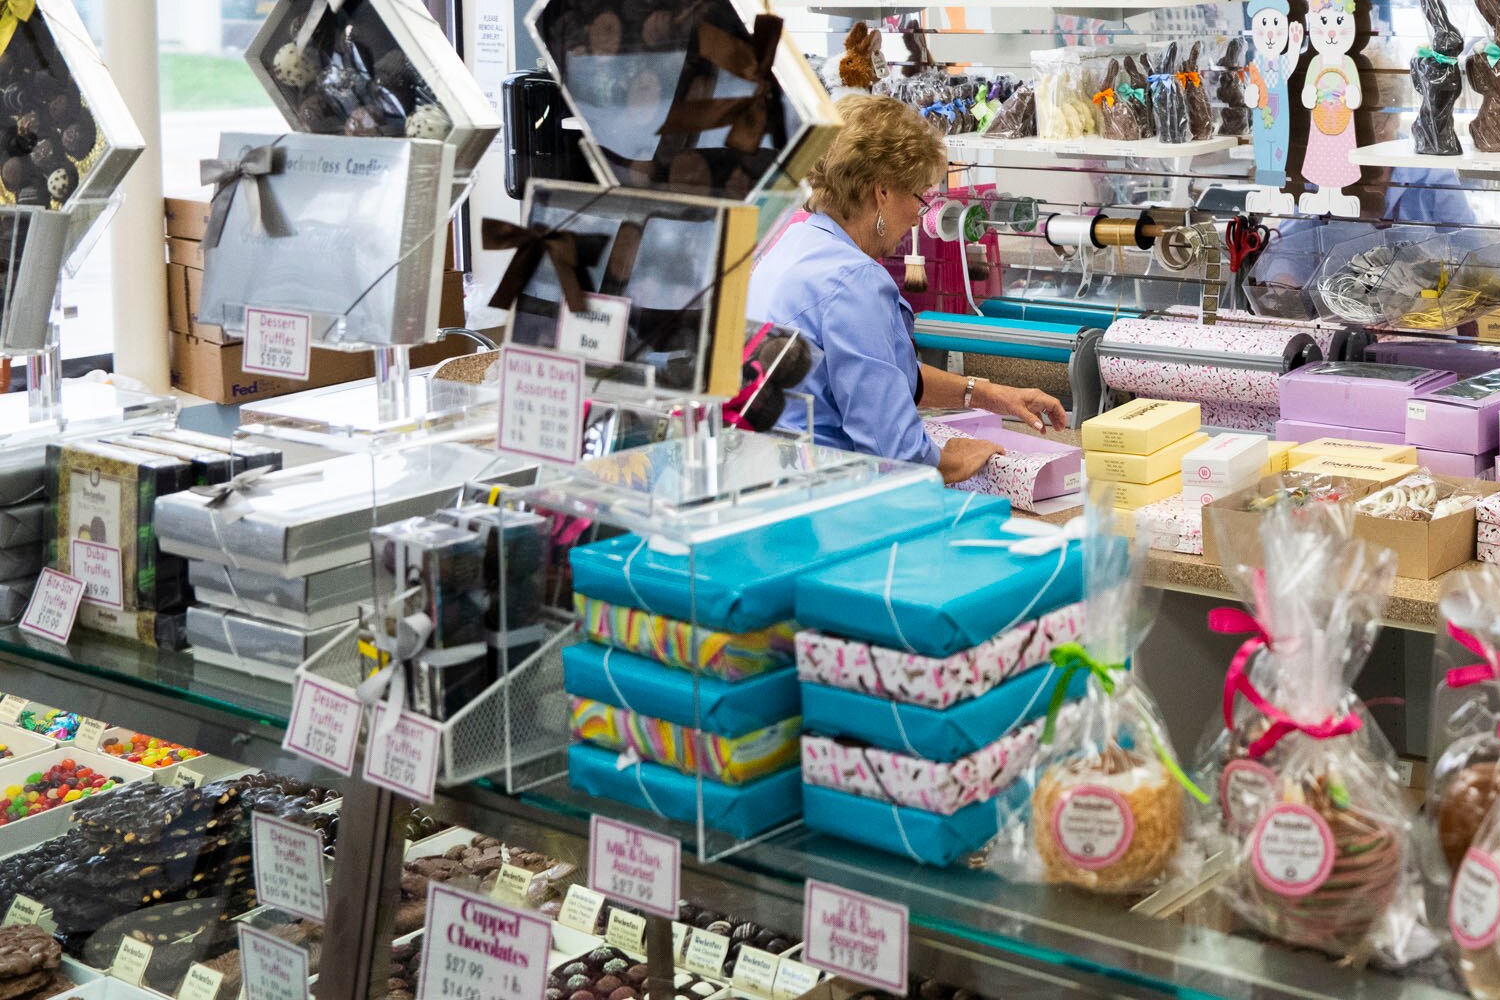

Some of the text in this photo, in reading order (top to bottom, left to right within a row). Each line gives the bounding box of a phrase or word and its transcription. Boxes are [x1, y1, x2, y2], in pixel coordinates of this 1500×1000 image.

[260, 314, 296, 330] Dessert
[260, 330, 296, 346] Truffles
[509, 359, 532, 375] Milk
[516, 380, 568, 401] Assorted
[86, 546, 108, 561] Dubai
[84, 563, 111, 579] Truffles
[86, 583, 109, 597] 19.99
[313, 688, 348, 716] Dessert
[310, 707, 344, 734] Truffles
[386, 734, 421, 762] Truffles
[270, 829, 307, 850] Dessert
[461, 899, 521, 937] Cupped
[447, 923, 529, 969] Chocolates
